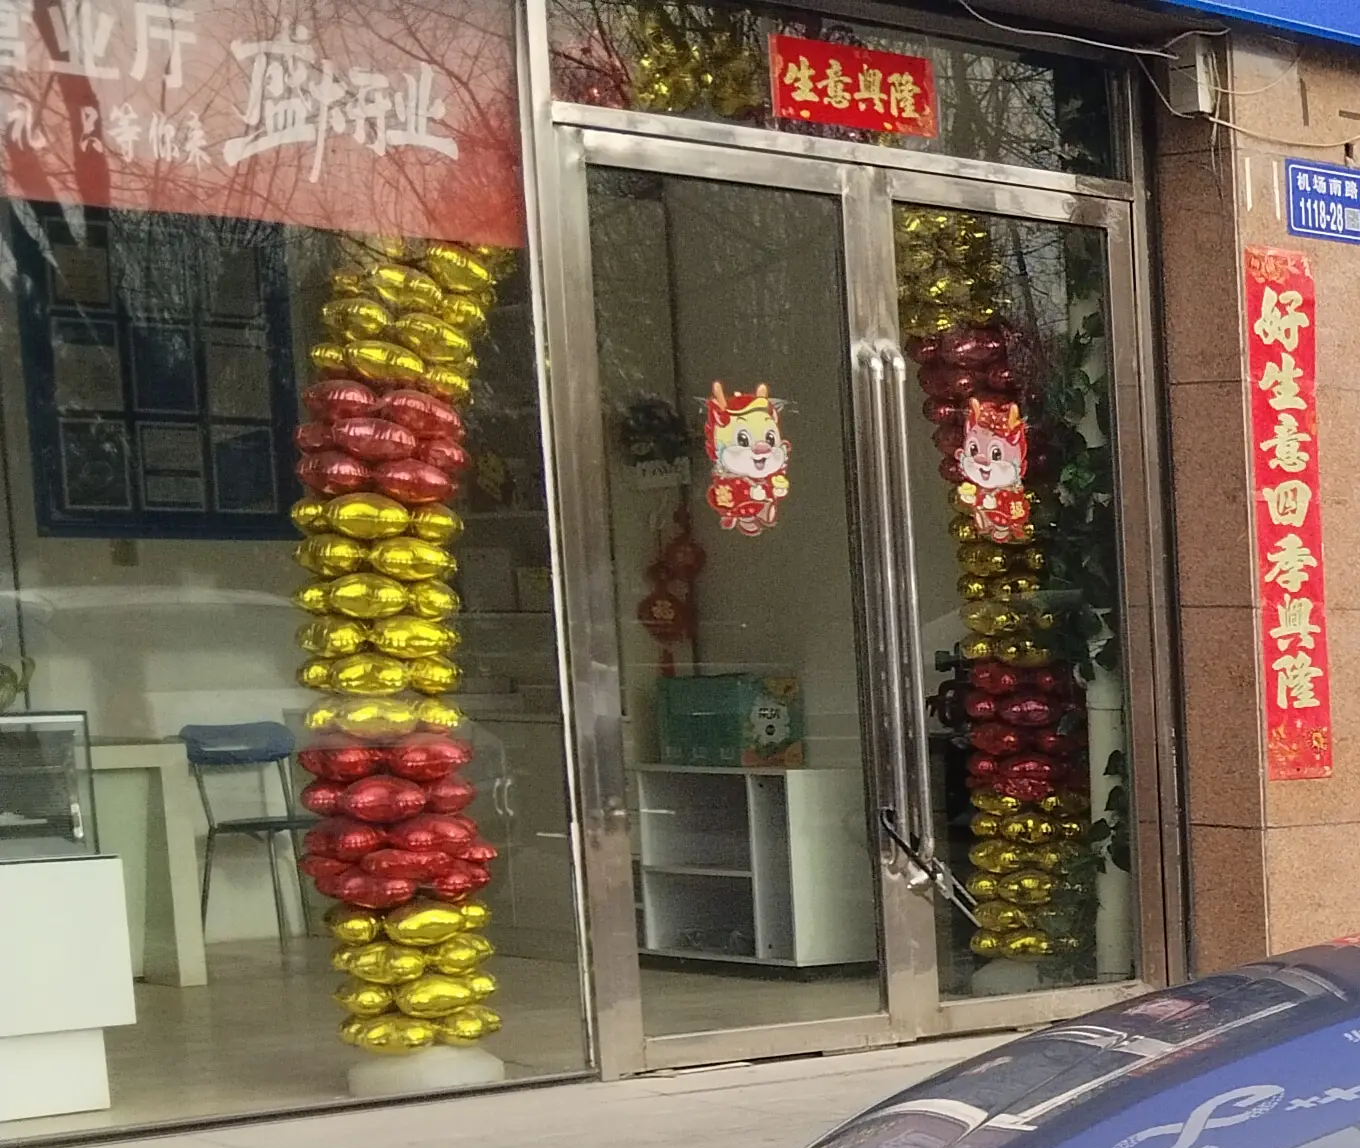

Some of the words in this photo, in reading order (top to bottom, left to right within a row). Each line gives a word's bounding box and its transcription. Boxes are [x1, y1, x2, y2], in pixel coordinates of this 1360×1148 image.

[1296, 171, 1359, 199] 机场南路
[1299, 197, 1344, 234] 1118-28
